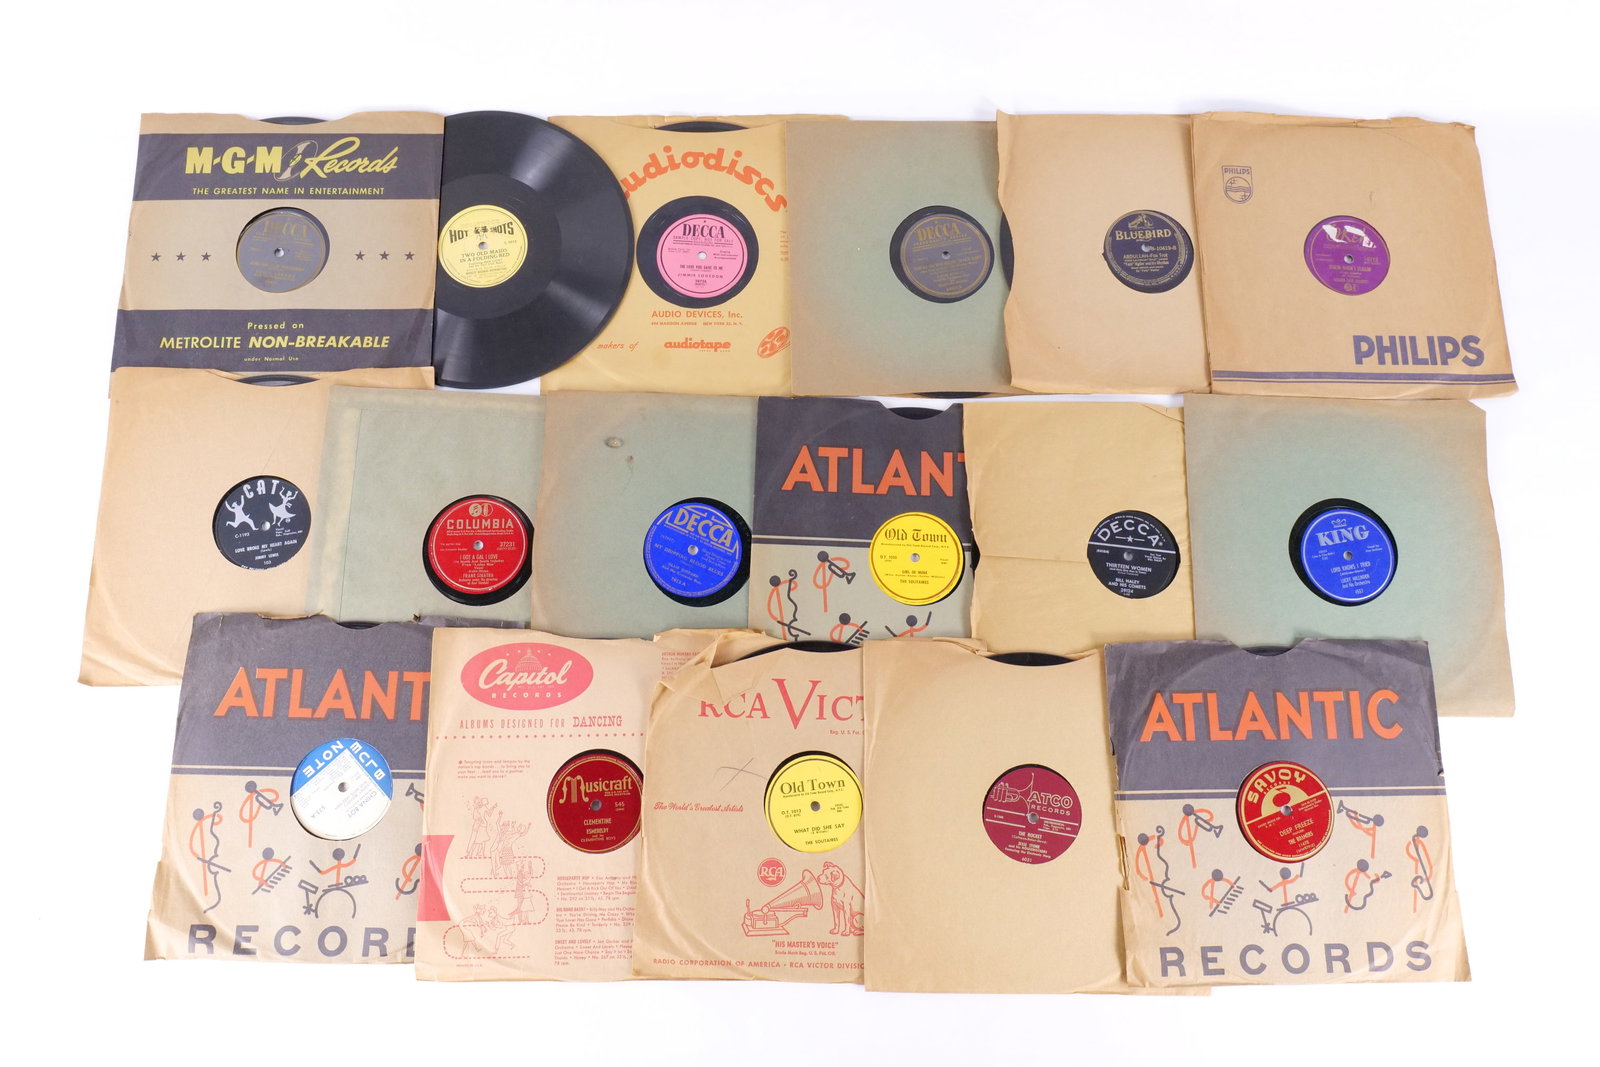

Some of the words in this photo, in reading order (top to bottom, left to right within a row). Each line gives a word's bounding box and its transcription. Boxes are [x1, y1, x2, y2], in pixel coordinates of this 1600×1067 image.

[185, 146, 283, 175] M-G-M
[300, 136, 399, 179] Records
[620, 145, 788, 213] udiodiscs
[1224, 167, 1251, 175] PHILIPS
[192, 187, 211, 195] THE
[213, 187, 257, 195] GREATEST
[261, 187, 289, 195] NAME
[294, 187, 304, 195] IN
[309, 187, 385, 195] ENTERTAINMENT
[449, 229, 468, 244] HOT
[490, 221, 515, 236] SHOTS
[682, 223, 725, 239] DECCA
[915, 223, 961, 241] DECCA
[1115, 229, 1172, 241] BLUEBIRD
[472, 254, 498, 262] FOLDING
[685, 311, 725, 319] DEVICES,
[247, 321, 286, 330] Pressed
[159, 337, 241, 349] METROLITE
[248, 335, 390, 349] NON-BREAKABLE
[628, 341, 639, 351] of
[664, 337, 731, 352] audiotape
[1352, 334, 1485, 367] PHILIPS
[242, 479, 280, 499] CAT
[446, 518, 514, 530] COLUMBIA
[673, 507, 735, 548] DECCA
[884, 528, 908, 541] Old
[912, 528, 948, 543] Town
[1097, 519, 1160, 547] DECCA
[1315, 524, 1370, 547] KING
[1106, 562, 1130, 570] THIRTEEN
[1131, 565, 1152, 573] WOMEN
[478, 658, 573, 691] Capitol
[459, 719, 494, 730] ALBUMS
[500, 719, 544, 729] DESIGNED
[550, 718, 566, 728] FOR
[572, 716, 623, 728] DANCING
[1140, 688, 1403, 742] ATLANTIC
[302, 740, 345, 778] NOTE
[349, 741, 386, 781] BLUE
[559, 775, 634, 804] Musicraft
[780, 780, 805, 795] Old
[807, 778, 846, 791] Town
[1247, 768, 1306, 804] SAVOY
[653, 801, 668, 811] The
[668, 802, 694, 811] World's
[695, 803, 720, 812] Greatest
[720, 804, 744, 813] Artists
[1027, 791, 1074, 809] ATCO
[1031, 804, 1071, 816] RECORDS
[583, 817, 612, 826] CLEMENTINE
[1279, 826, 1293, 837] DEEP
[1294, 818, 1314, 830] FREEZE
[760, 866, 784, 880] RCA
[786, 941, 816, 949] MASTER'S
[679, 959, 732, 967] CORPORATION
[1159, 941, 1432, 978] RECORDS
